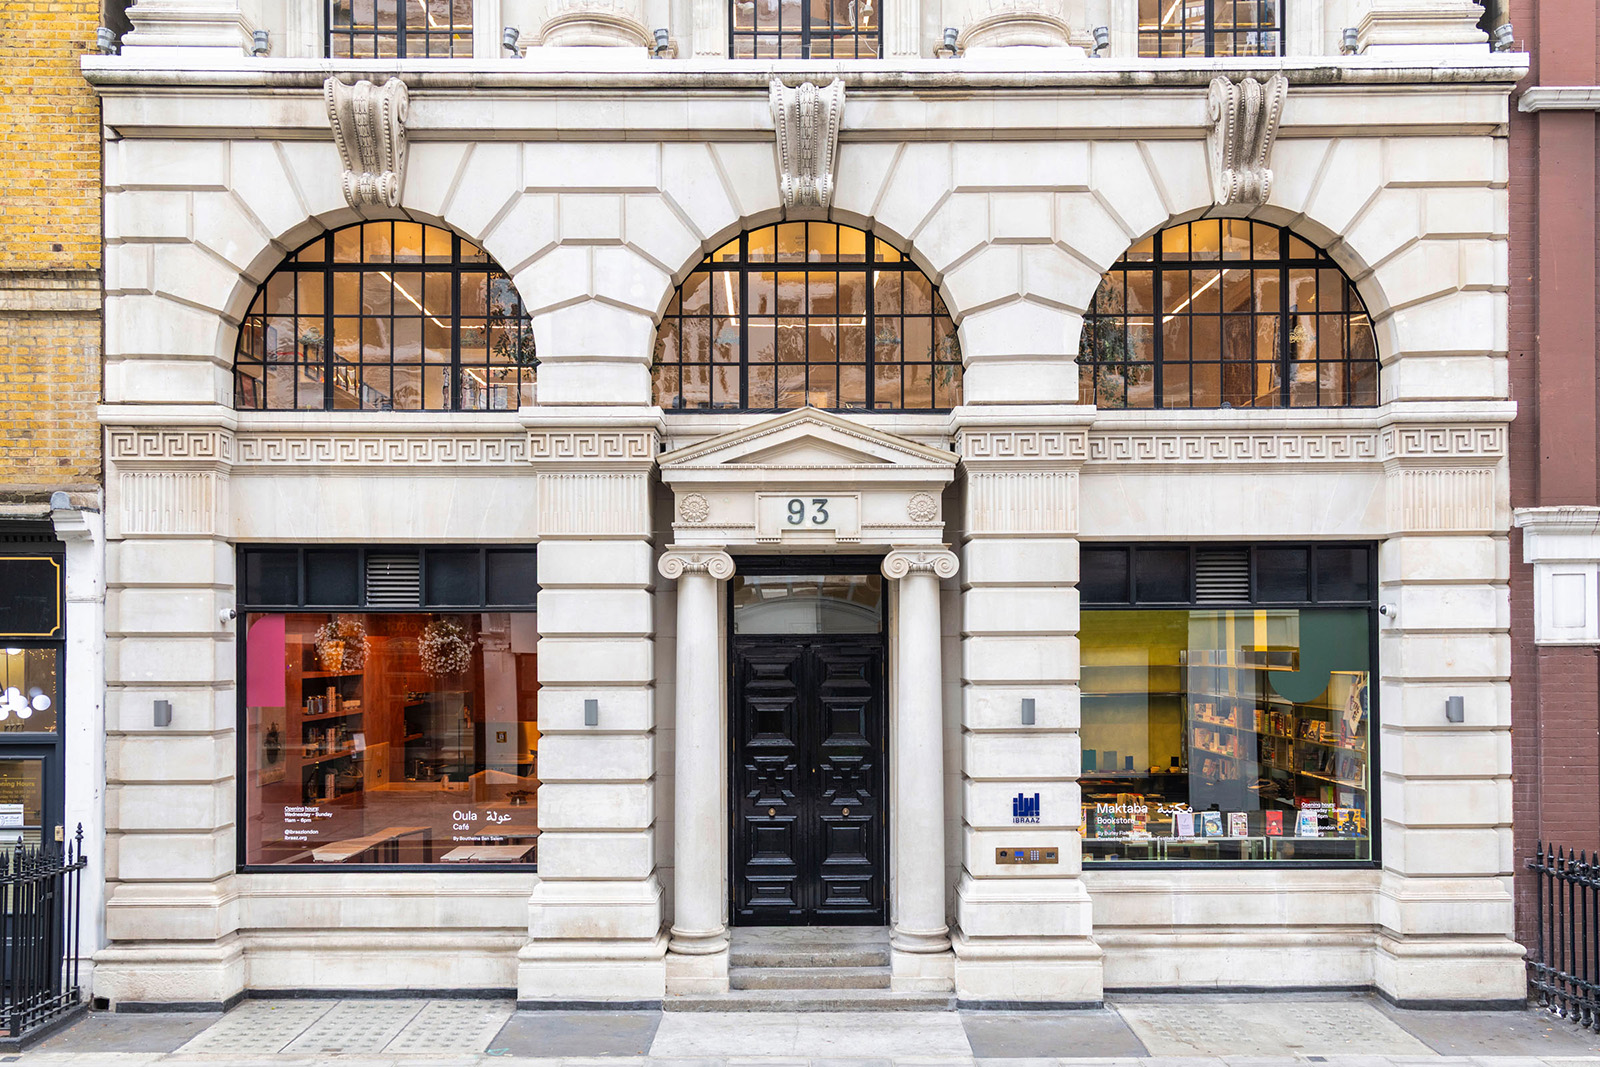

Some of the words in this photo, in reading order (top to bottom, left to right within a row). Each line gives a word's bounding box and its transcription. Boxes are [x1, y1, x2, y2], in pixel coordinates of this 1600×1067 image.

[787, 498, 829, 525] 93
[1097, 803, 1148, 814] Maktaba
[1157, 802, 1194, 817] مكتبة
[453, 810, 478, 821] Oula
[486, 811, 512, 825] عولة
[1097, 816, 1136, 824] Bookstore
